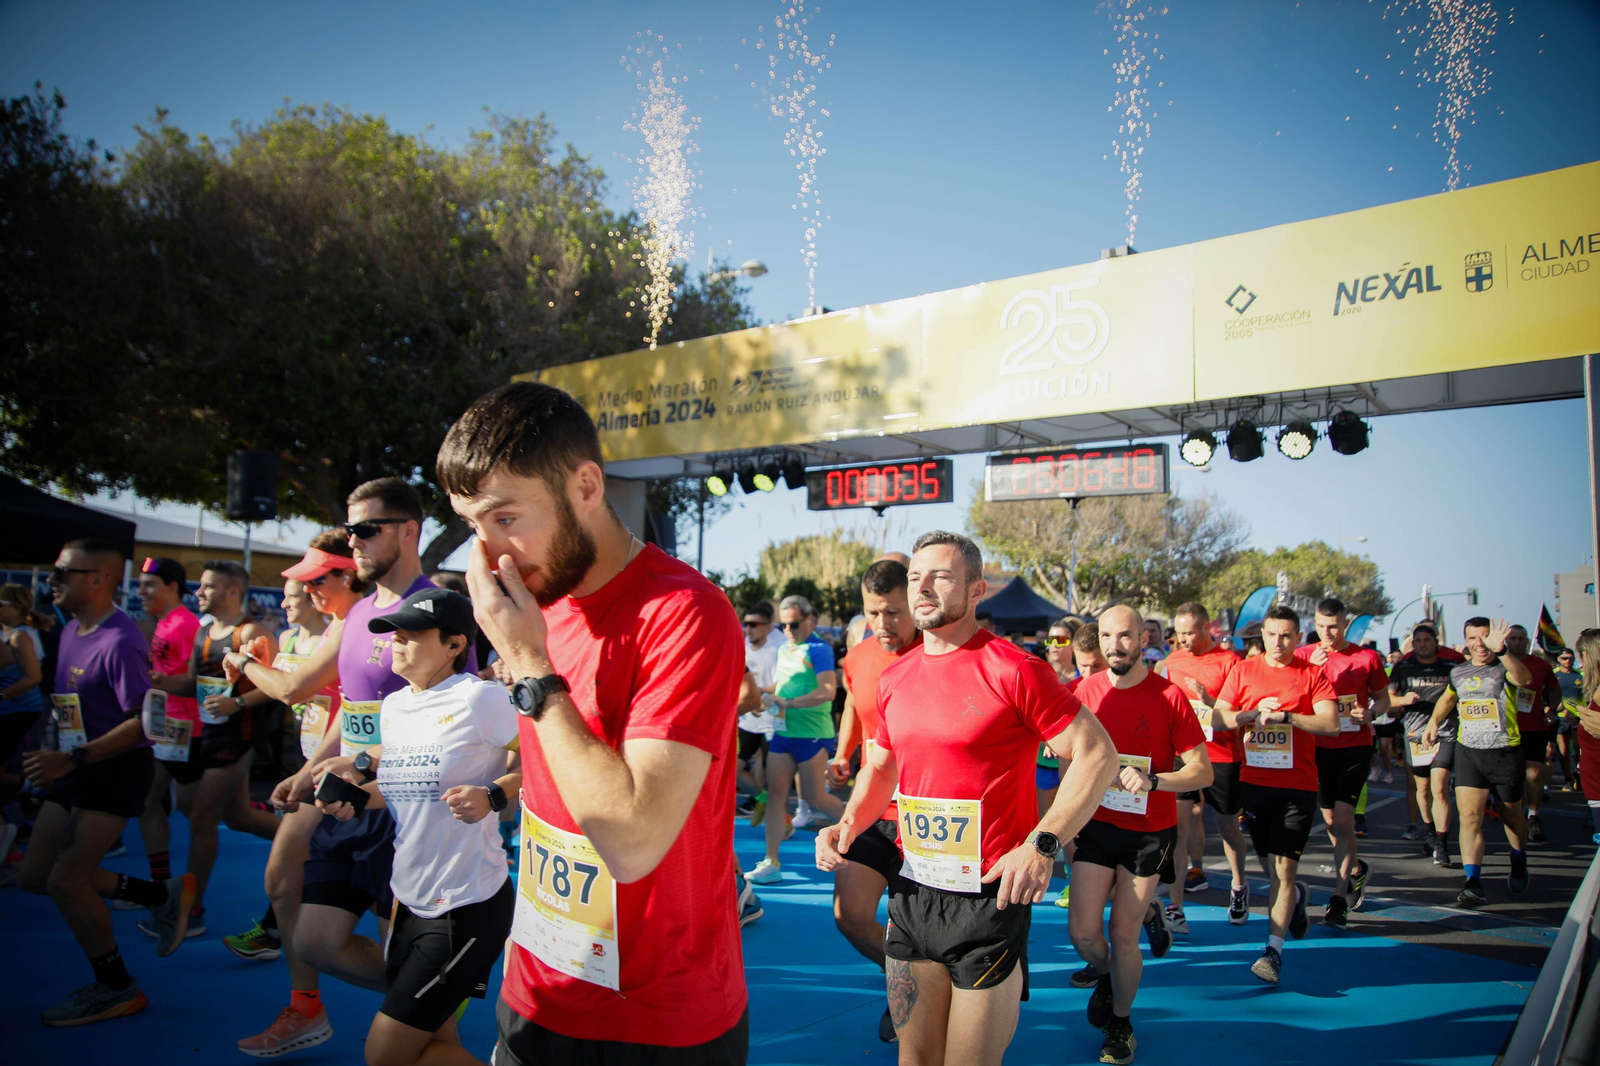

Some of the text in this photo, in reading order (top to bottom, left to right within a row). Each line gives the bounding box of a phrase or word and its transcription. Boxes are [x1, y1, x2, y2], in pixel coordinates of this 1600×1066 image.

[1521, 232, 1600, 265] ALME
[1521, 259, 1590, 282] CIUDAD
[1333, 262, 1442, 316] NEXAL
[1224, 308, 1311, 329] COOPERACIÓN
[1341, 306, 1362, 315] 2020
[1000, 276, 1111, 376] 25
[1225, 328, 1254, 340] 2005
[598, 387, 643, 408] Medio
[648, 376, 718, 400] Maratón
[726, 397, 772, 416] RAMÓN
[776, 394, 809, 410] RUIZ
[812, 384, 880, 405] ANDÚJAR
[597, 396, 717, 431] Almería 2024
[1466, 705, 1489, 715] 686
[399, 743, 444, 755] Maratón
[1249, 731, 1287, 745] 2009
[405, 754, 441, 767] 2024
[386, 772, 402, 780] RUIZ
[401, 770, 441, 780] ANDÚJAR
[903, 812, 970, 843] 1937
[920, 841, 943, 850] JESUS
[526, 836, 599, 905] 1787
